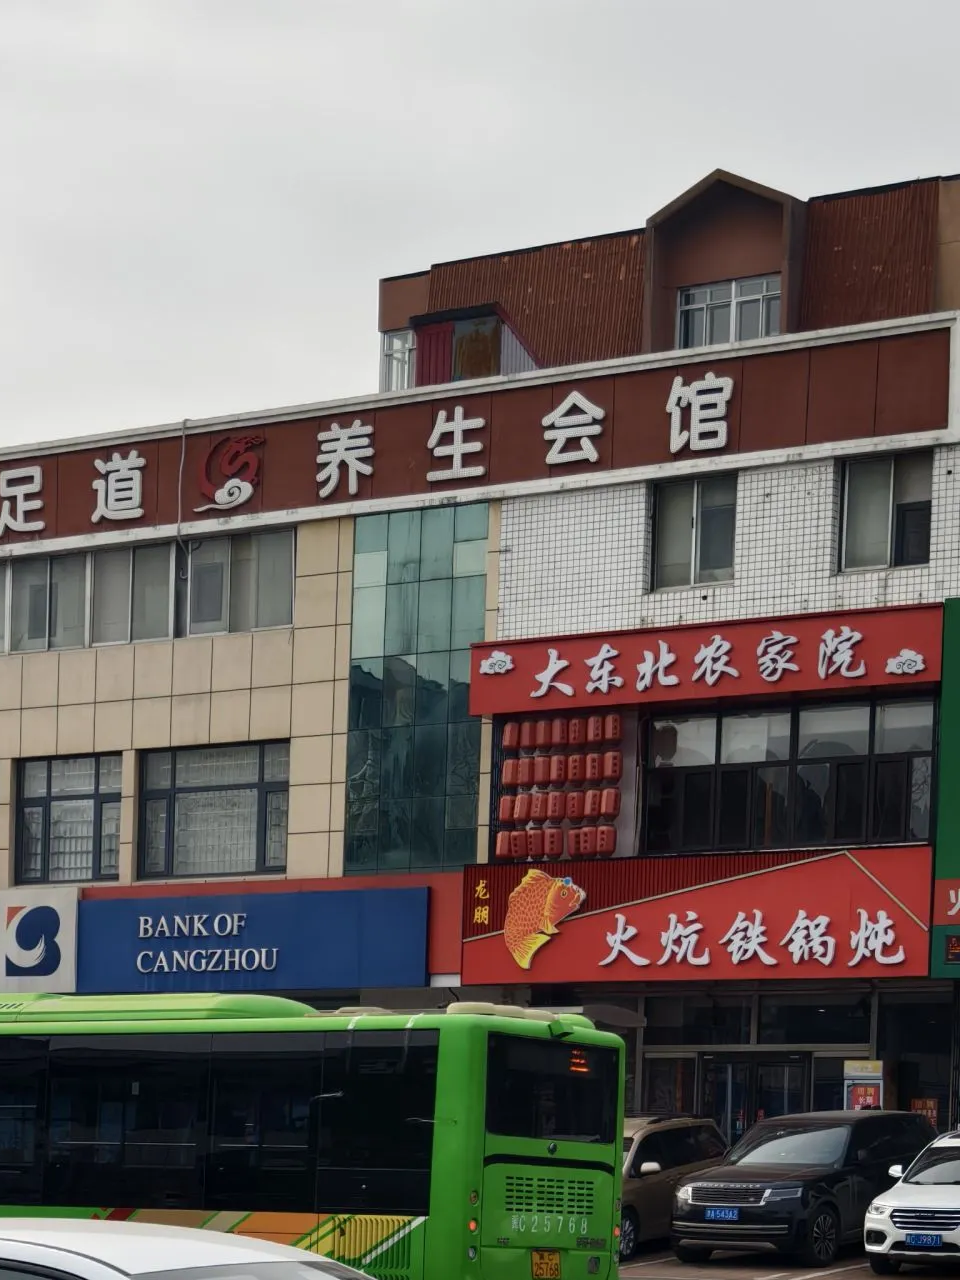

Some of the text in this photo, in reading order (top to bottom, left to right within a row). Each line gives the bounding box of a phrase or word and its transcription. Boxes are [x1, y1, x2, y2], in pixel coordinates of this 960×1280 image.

[315, 370, 733, 499] 养生会馆
[529, 625, 869, 699] 大东北农家院
[138, 912, 247, 939] BANK OF
[473, 879, 491, 927] 龙朋
[136, 946, 279, 975] CANGZHOU
[598, 908, 905, 968] 火炕铁锅炖
[534, 1262, 559, 1277] 25768
